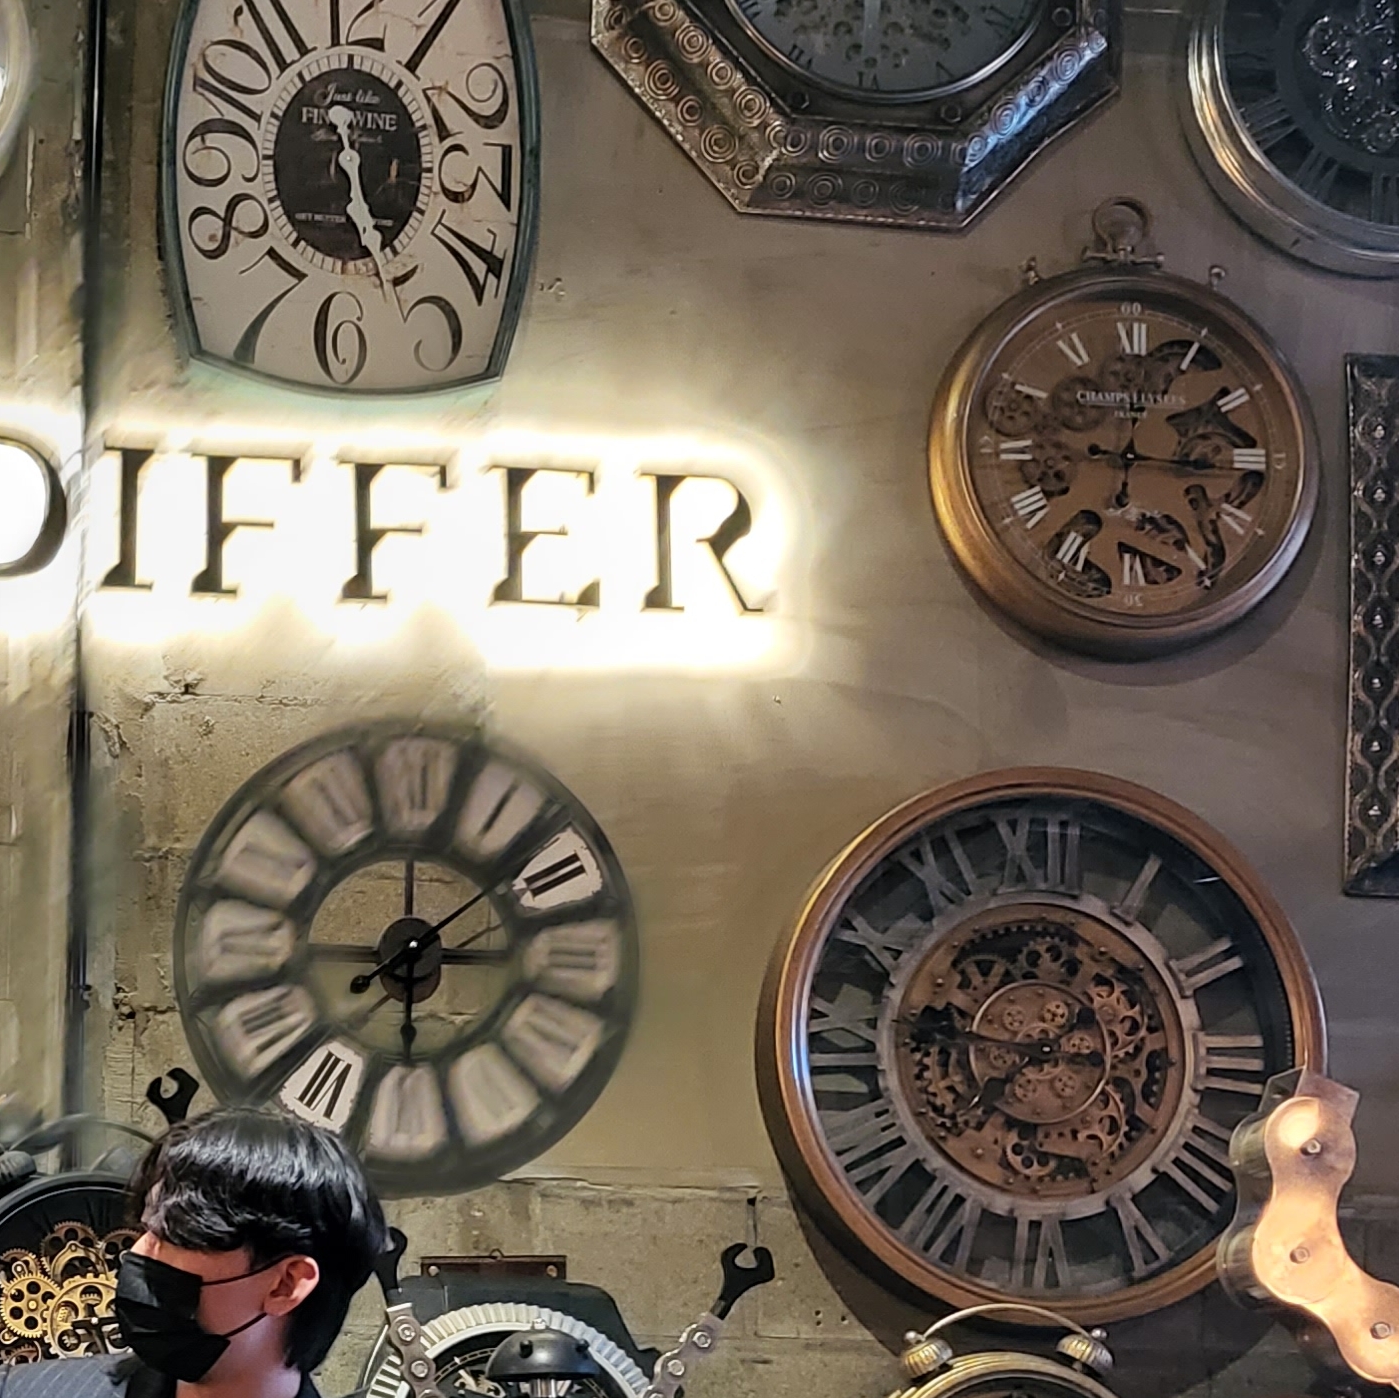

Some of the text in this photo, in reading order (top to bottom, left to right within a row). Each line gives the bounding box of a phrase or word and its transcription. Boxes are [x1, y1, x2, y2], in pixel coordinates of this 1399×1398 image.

[193, 39, 272, 130] 10
[302, 107, 332, 125] FIN
[423, 62, 510, 143] 2
[182, 118, 260, 188] 9
[438, 143, 512, 212] 3
[188, 193, 269, 260] 8
[431, 209, 507, 306] 4
[233, 246, 308, 364] 7
[313, 291, 367, 385] 6
[392, 264, 463, 372] 5
[994, 817, 1081, 892] XII
